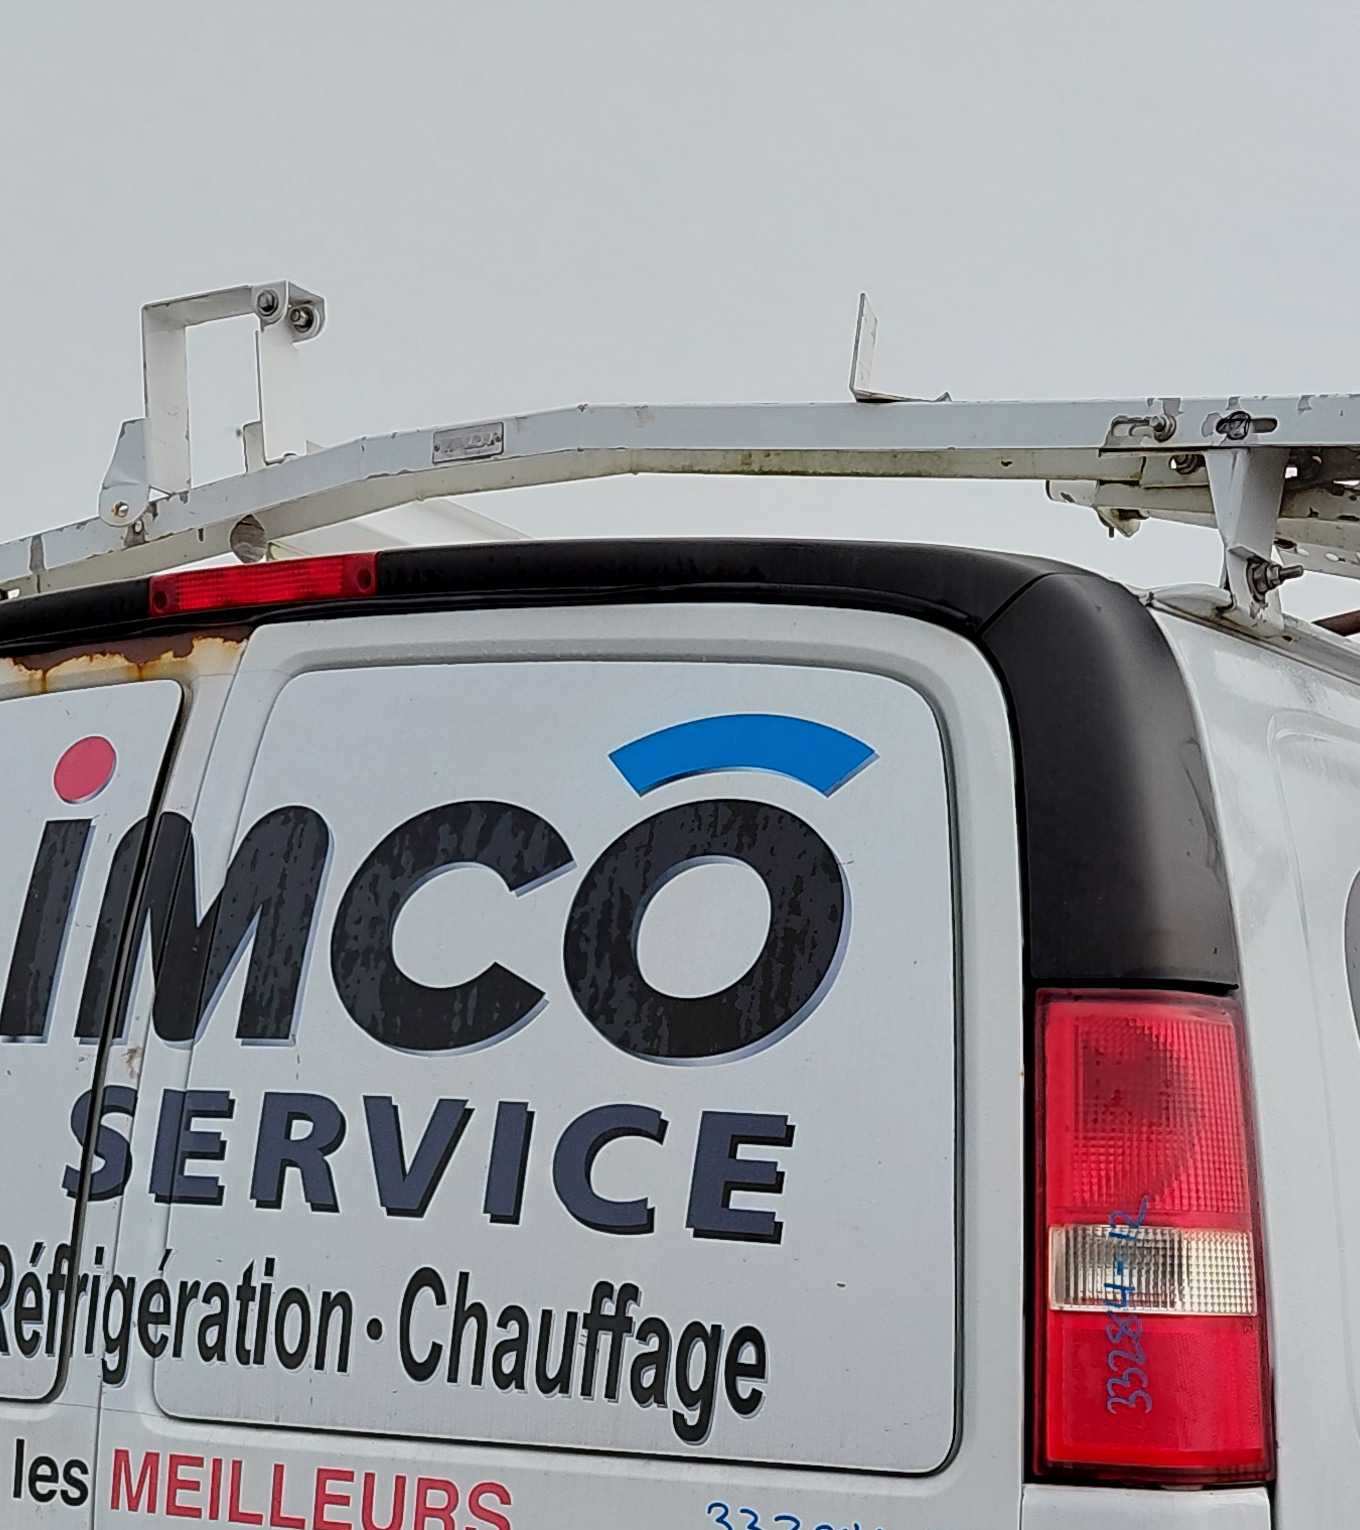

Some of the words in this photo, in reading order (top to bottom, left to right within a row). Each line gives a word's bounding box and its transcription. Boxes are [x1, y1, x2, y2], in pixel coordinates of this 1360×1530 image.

[62, 1085, 795, 1245] SERVICE
[398, 1266, 769, 1443] Chauffage
[13, 1438, 90, 1507] les
